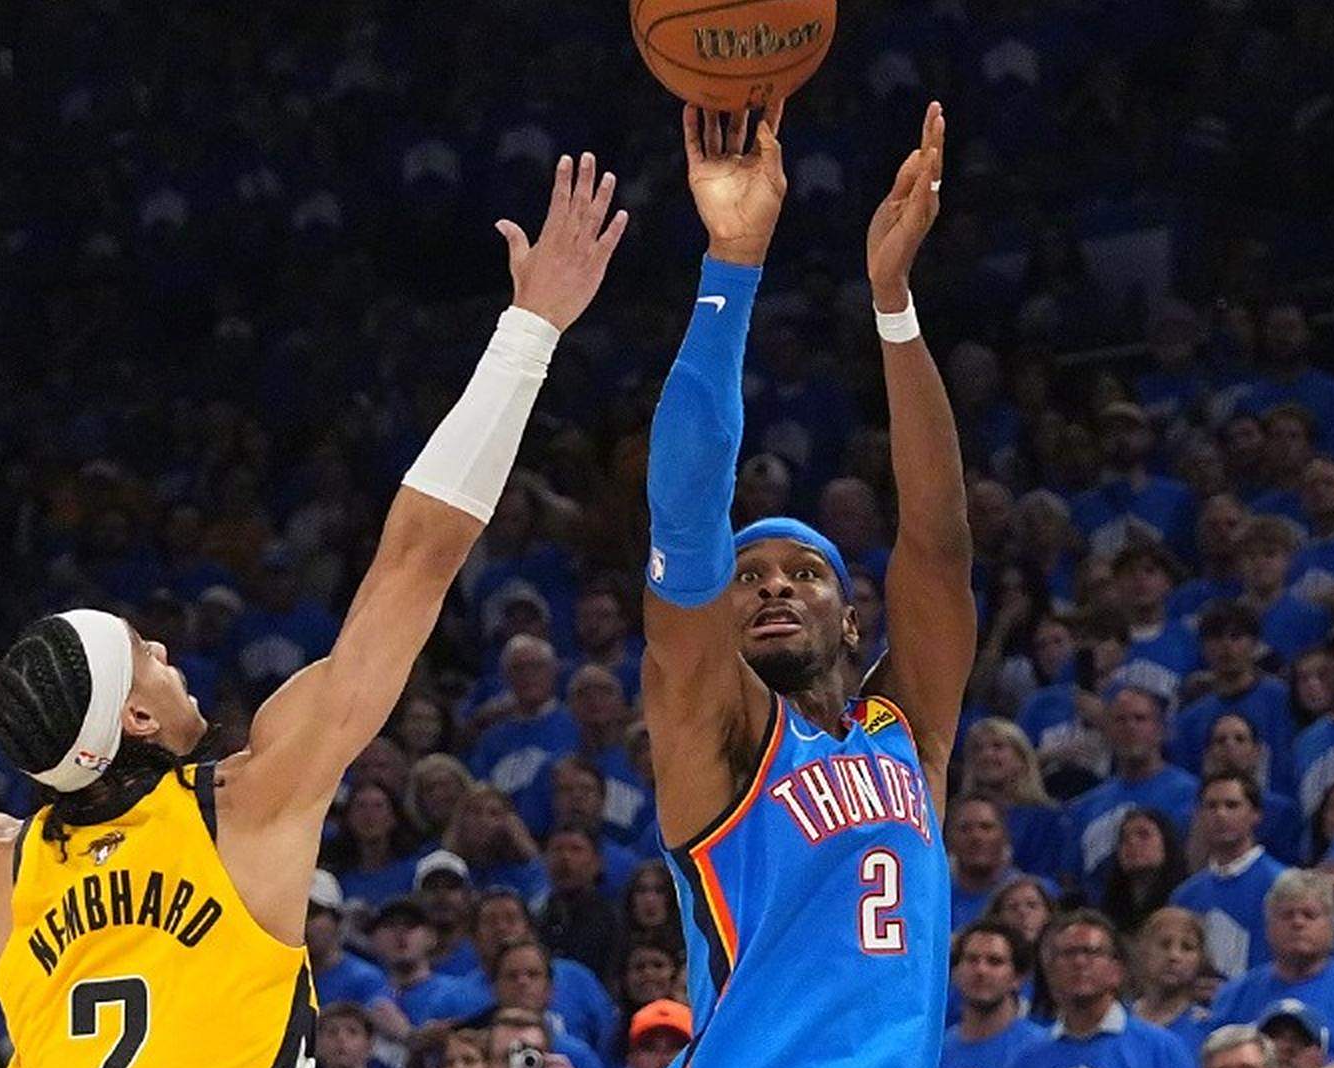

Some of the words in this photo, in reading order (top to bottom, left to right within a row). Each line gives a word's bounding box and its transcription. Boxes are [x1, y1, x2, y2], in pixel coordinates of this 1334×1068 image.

[693, 20, 821, 60] Wilson
[28, 870, 223, 976] NEMBHARD
[858, 846, 907, 954] 2
